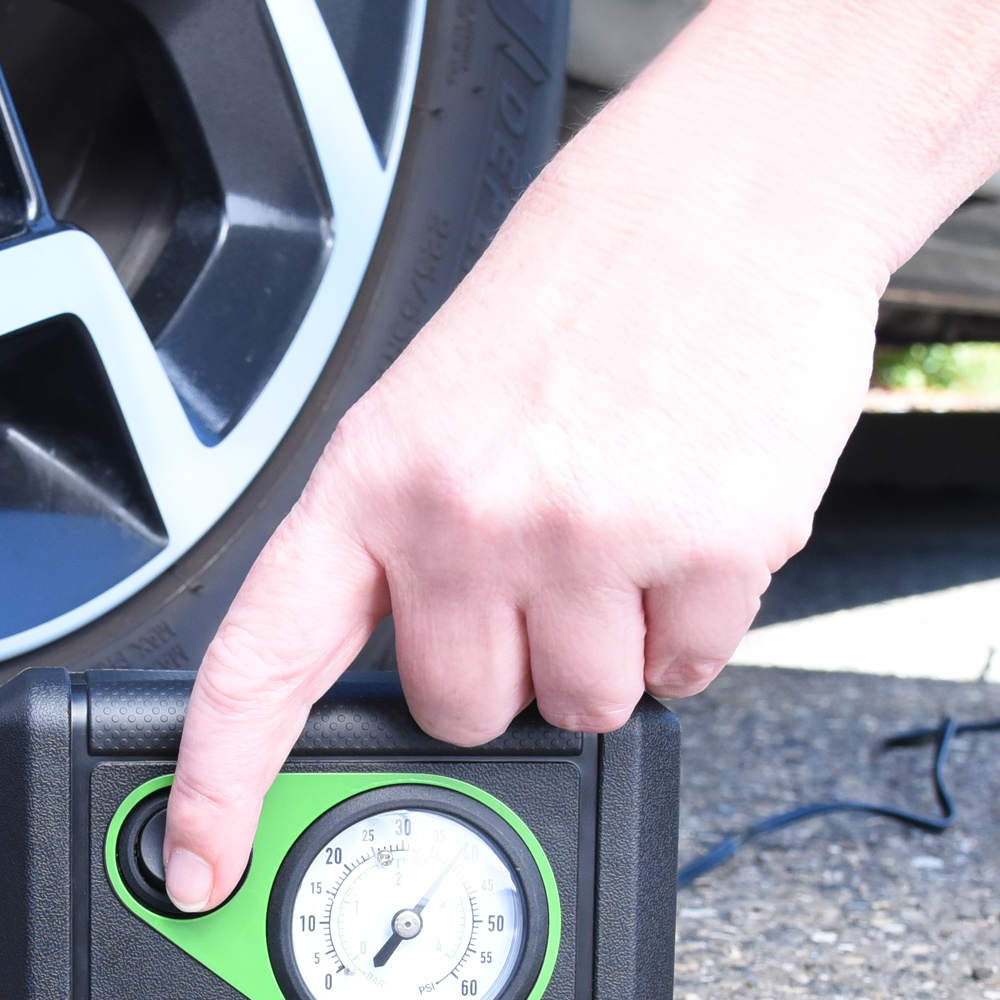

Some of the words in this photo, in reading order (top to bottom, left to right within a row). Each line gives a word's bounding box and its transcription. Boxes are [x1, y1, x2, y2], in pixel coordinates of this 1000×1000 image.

[395, 818, 412, 836] 30
[362, 829, 375, 842] 25
[433, 830, 446, 842] 35
[325, 847, 342, 865] 20
[462, 845, 479, 862] 40
[395, 872, 402, 886] 2
[481, 879, 494, 891] 45
[310, 882, 322, 894] 15
[300, 915, 316, 932] 10
[488, 915, 504, 932] 50
[360, 941, 367, 955] 0
[314, 952, 320, 965] 5
[480, 951, 493, 964] 55
[325, 973, 333, 990] 0
[365, 971, 386, 989] BAR
[418, 982, 436, 995] PSI
[461, 980, 478, 996] 60
